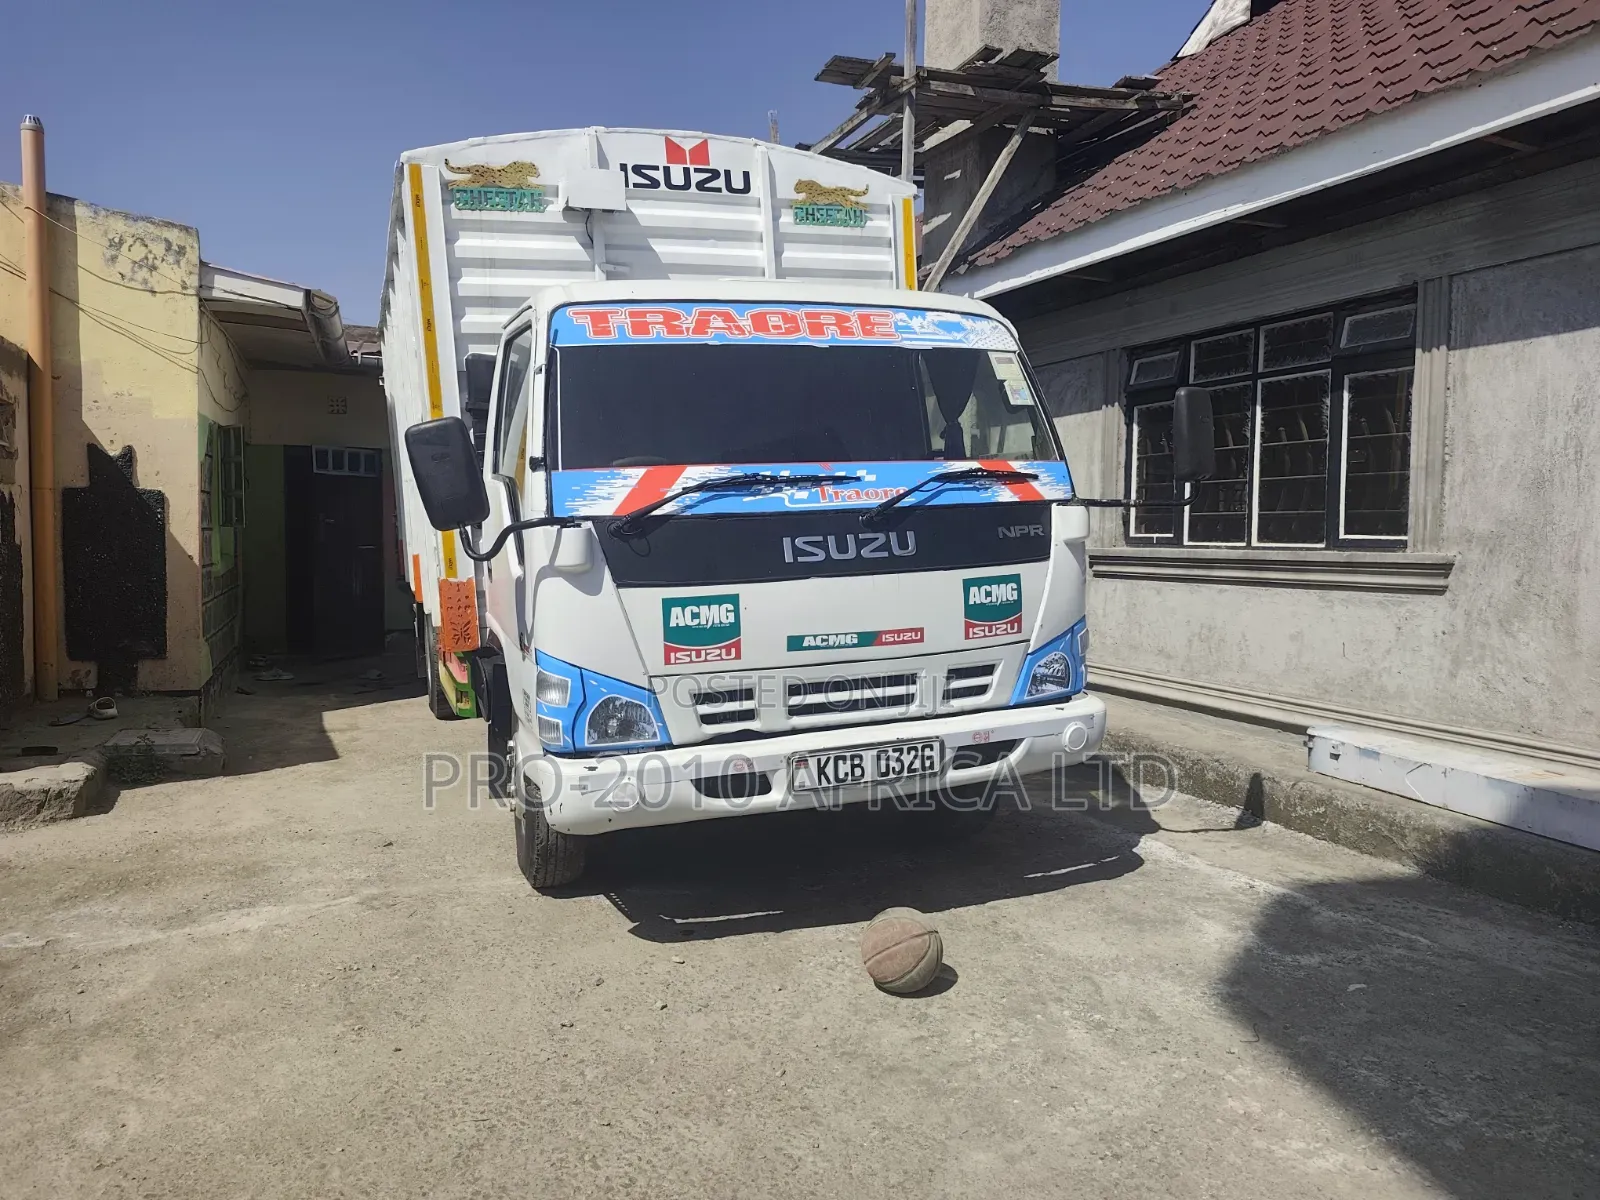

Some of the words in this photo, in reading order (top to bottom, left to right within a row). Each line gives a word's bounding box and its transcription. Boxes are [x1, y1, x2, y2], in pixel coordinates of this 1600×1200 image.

[620, 163, 752, 195] ISUZU
[567, 307, 901, 339] TRAORE
[997, 524, 1045, 538] NPR
[782, 530, 917, 563] ISUZU
[968, 582, 1018, 606] ACMG
[668, 603, 735, 629] ACMG
[802, 633, 859, 647] ACMG
[882, 631, 921, 642] ISUZU
[968, 622, 1018, 639] ISUZU
[670, 647, 736, 664] ISUZU
[816, 753, 866, 787] KCB
[876, 743, 935, 778] 032G
